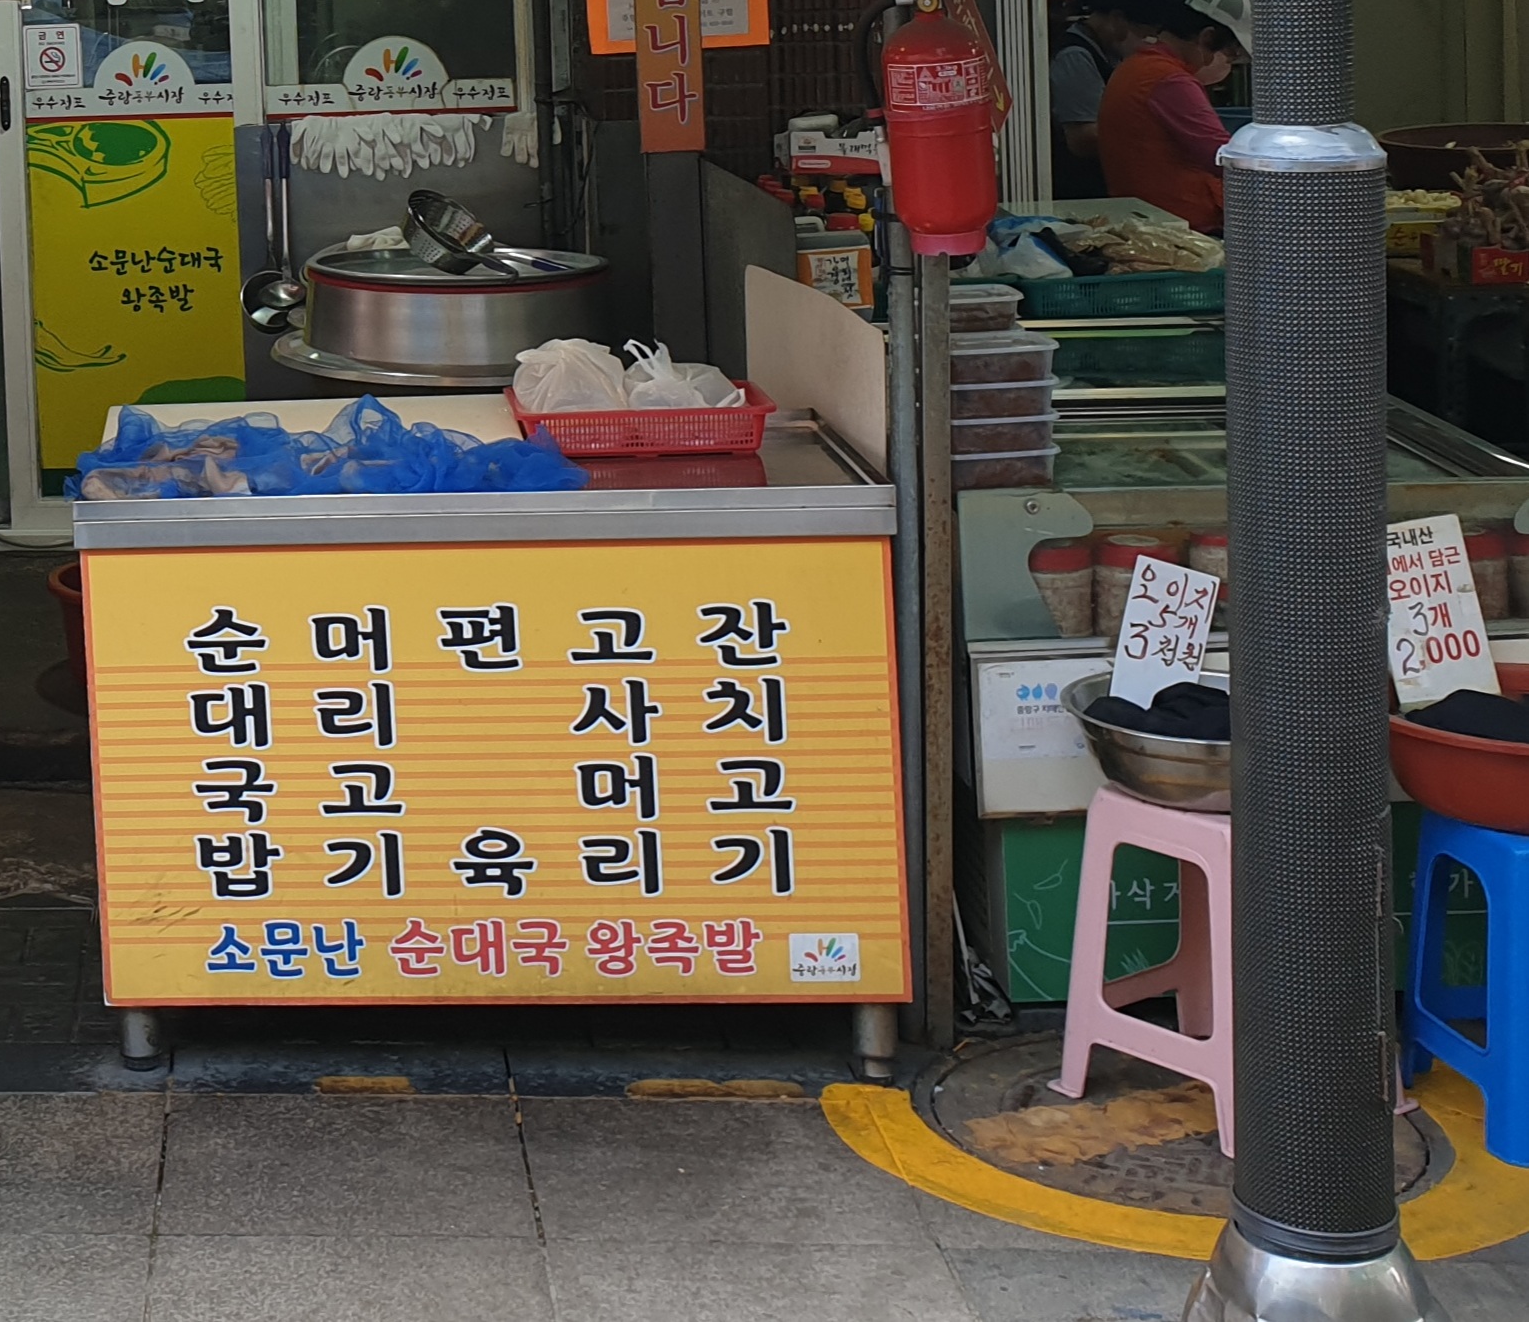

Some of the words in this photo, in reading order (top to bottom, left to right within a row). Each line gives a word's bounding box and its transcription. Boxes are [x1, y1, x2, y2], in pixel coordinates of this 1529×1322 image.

[120, 283, 195, 312] 왕족발
[1386, 526, 1434, 549] 국내산
[1386, 553, 1424, 576] 에서
[1389, 570, 1454, 601] 오이지
[1131, 563, 1218, 624] 오이지
[1147, 604, 1199, 640] 5개
[1408, 601, 1453, 637] 3개
[1396, 629, 1481, 676] 2,000
[184, 605, 282, 901] 순대국밥
[311, 604, 406, 900] 머리고기
[567, 606, 662, 897] 고사머리
[696, 598, 796, 896] 잔치고기
[206, 920, 365, 979] 소문난
[387, 917, 568, 977] 순대국
[585, 917, 763, 976] 왕족발
